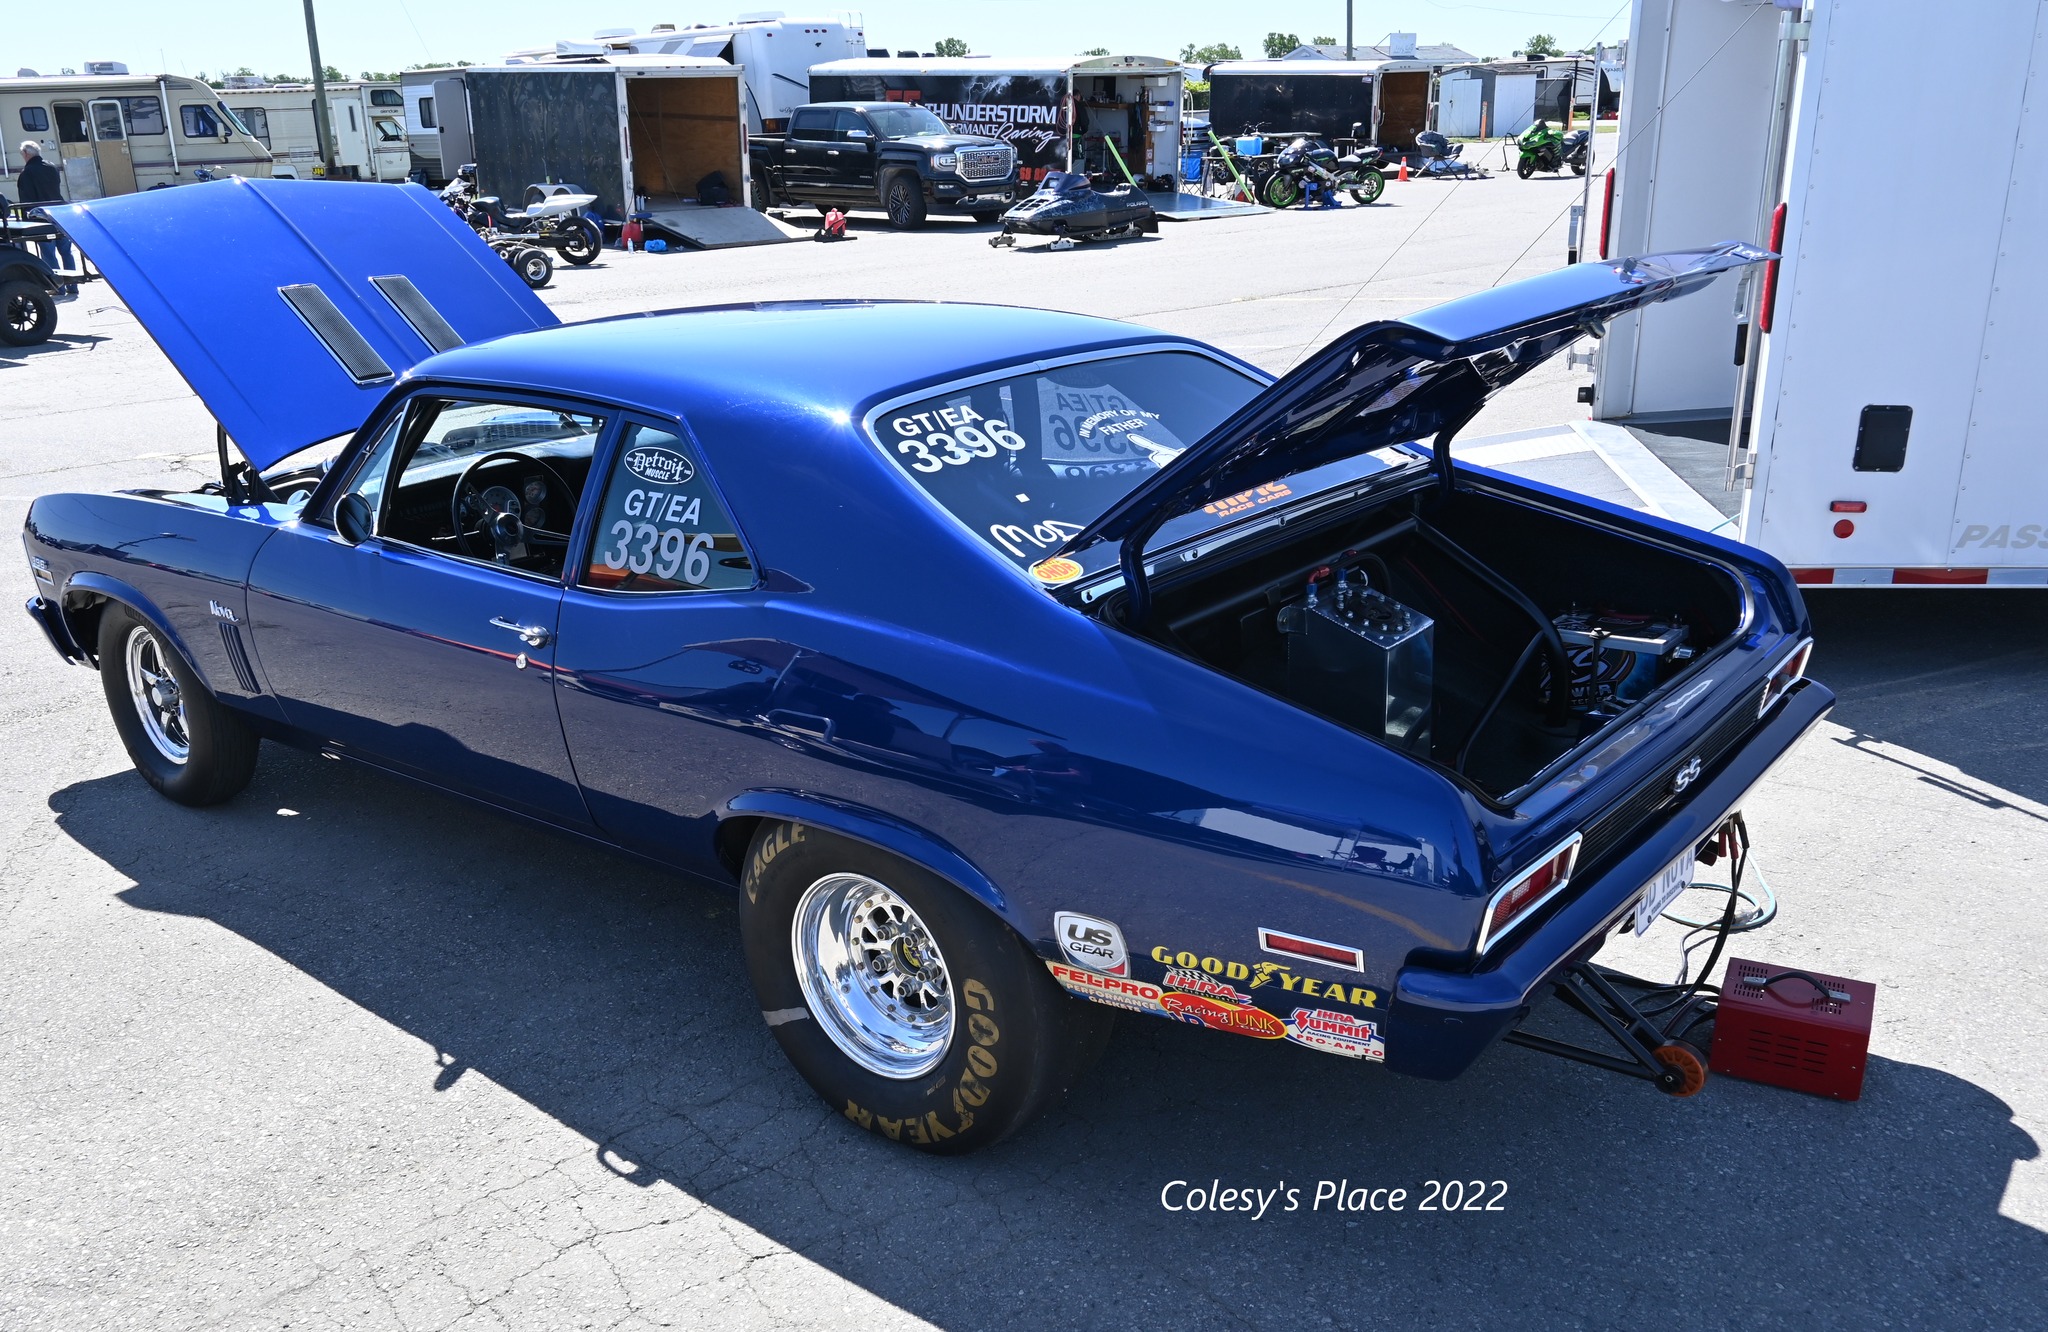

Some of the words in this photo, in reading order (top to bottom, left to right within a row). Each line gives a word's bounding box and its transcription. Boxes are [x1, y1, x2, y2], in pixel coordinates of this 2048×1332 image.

[924, 103, 1057, 124] THUNDERSTORM
[926, 122, 998, 136] PERRMANCE
[993, 121, 1060, 153] Racing
[893, 405, 984, 437] GT/EA
[1081, 409, 1119, 431] MEMORY
[1119, 409, 1137, 417] OF
[1139, 411, 1160, 420] MY
[1079, 428, 1091, 438] IN
[1098, 418, 1148, 436] FATHER
[898, 419, 1026, 473] 3396
[632, 452, 685, 482] Detroit
[644, 467, 671, 481] MUSCLE
[624, 489, 701, 525] GT/EA
[1218, 501, 1255, 517] RACE
[1257, 489, 1292, 504] CARS
[604, 520, 715, 585] 3396
[209, 600, 240, 622] Nova
[1672, 757, 1702, 795] SS
[745, 822, 805, 904] EAGLE
[1067, 923, 1113, 947] US
[1069, 942, 1115, 959] GEAR
[1066, 983, 1158, 1011] PERFORMANCE
[1165, 974, 1238, 1001] IHRA
[1316, 1010, 1356, 1025] IHRA
[1296, 1033, 1356, 1051] PRO-AM
[1306, 1031, 1332, 1039] RACING
[1332, 1036, 1371, 1047] EQUIPMENT
